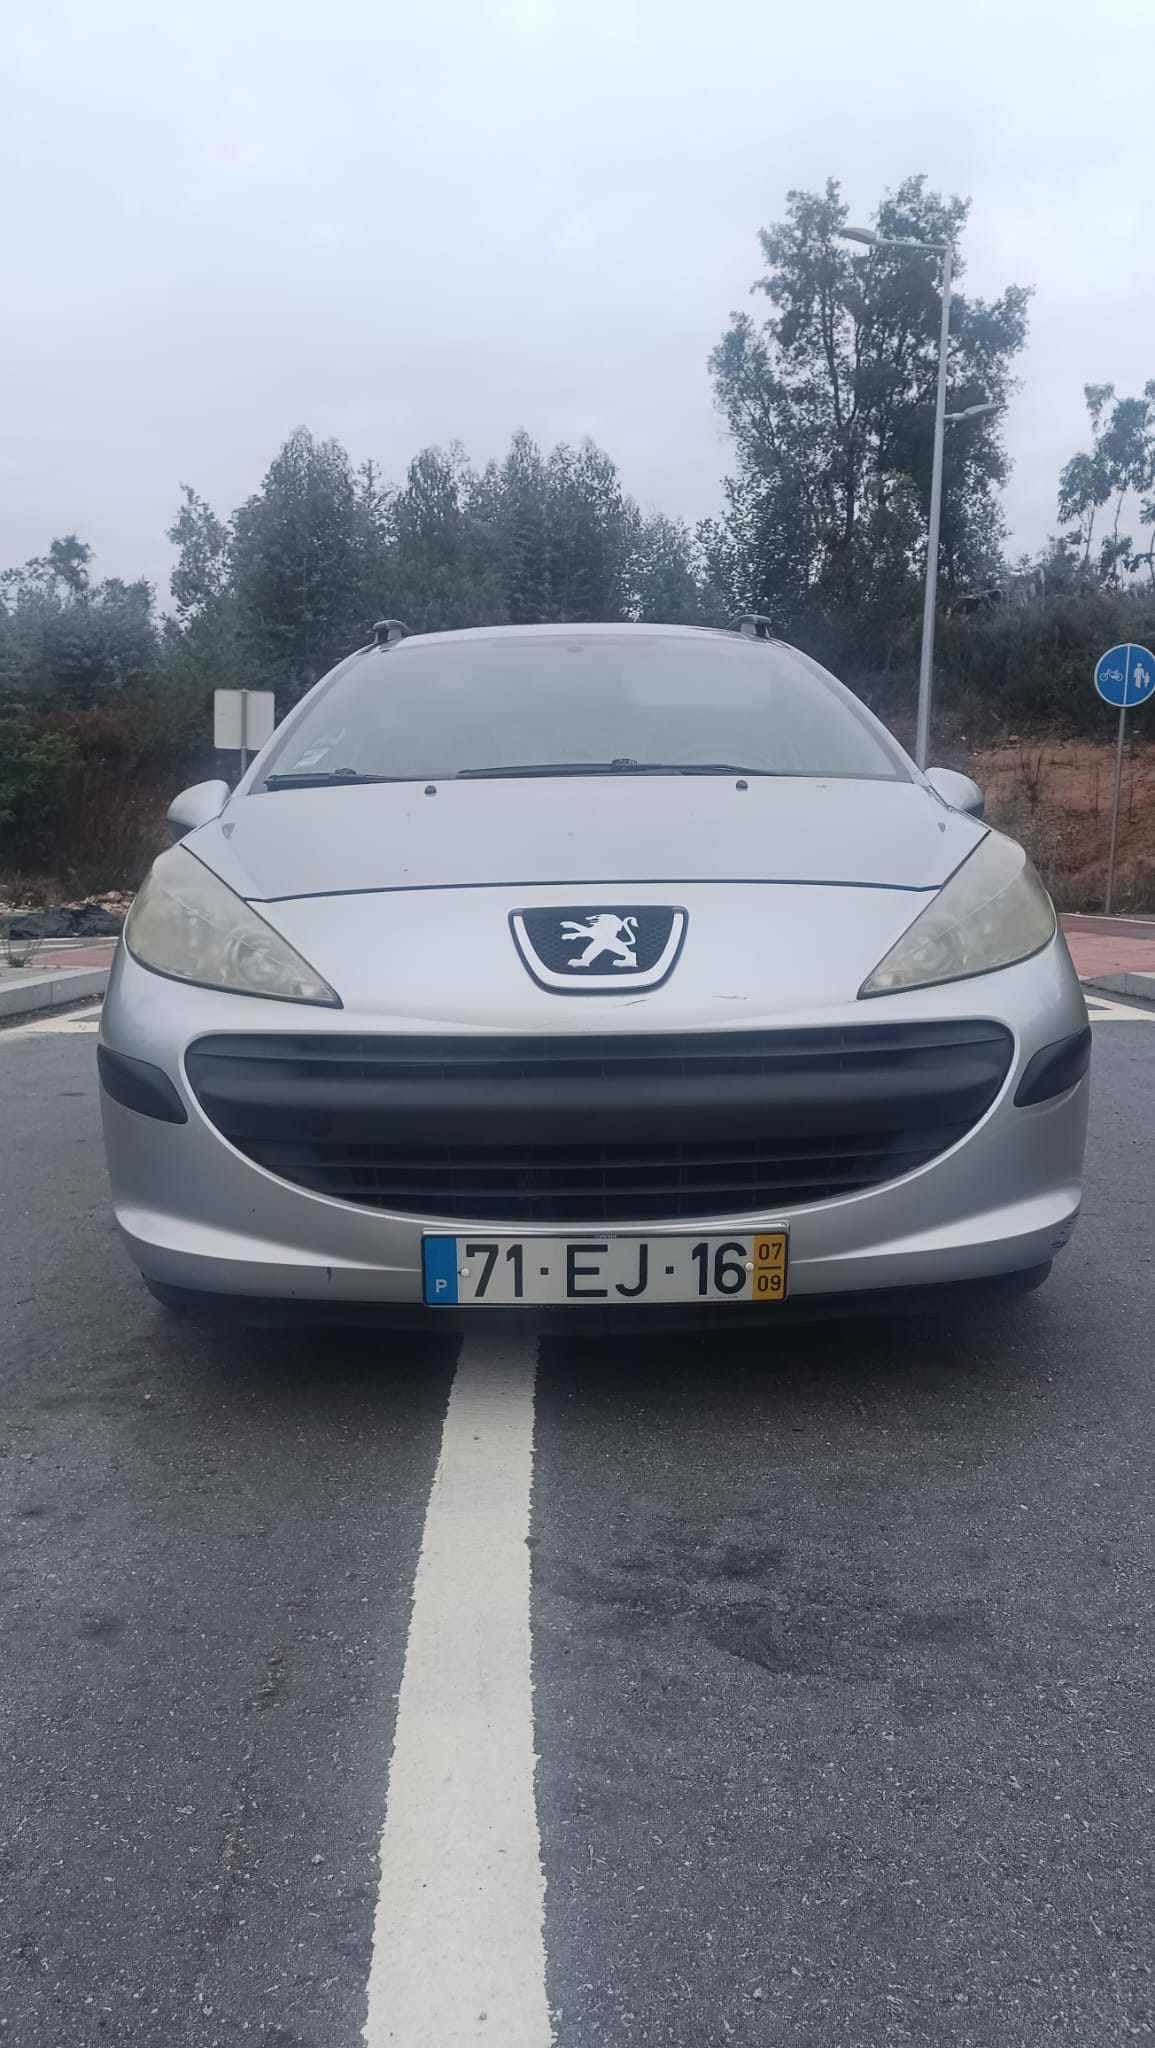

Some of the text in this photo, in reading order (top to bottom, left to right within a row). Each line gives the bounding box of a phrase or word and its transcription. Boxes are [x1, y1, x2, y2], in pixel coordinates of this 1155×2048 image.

[758, 1242, 783, 1261] 07
[434, 1278, 448, 1293] P
[757, 1274, 782, 1293] 09
